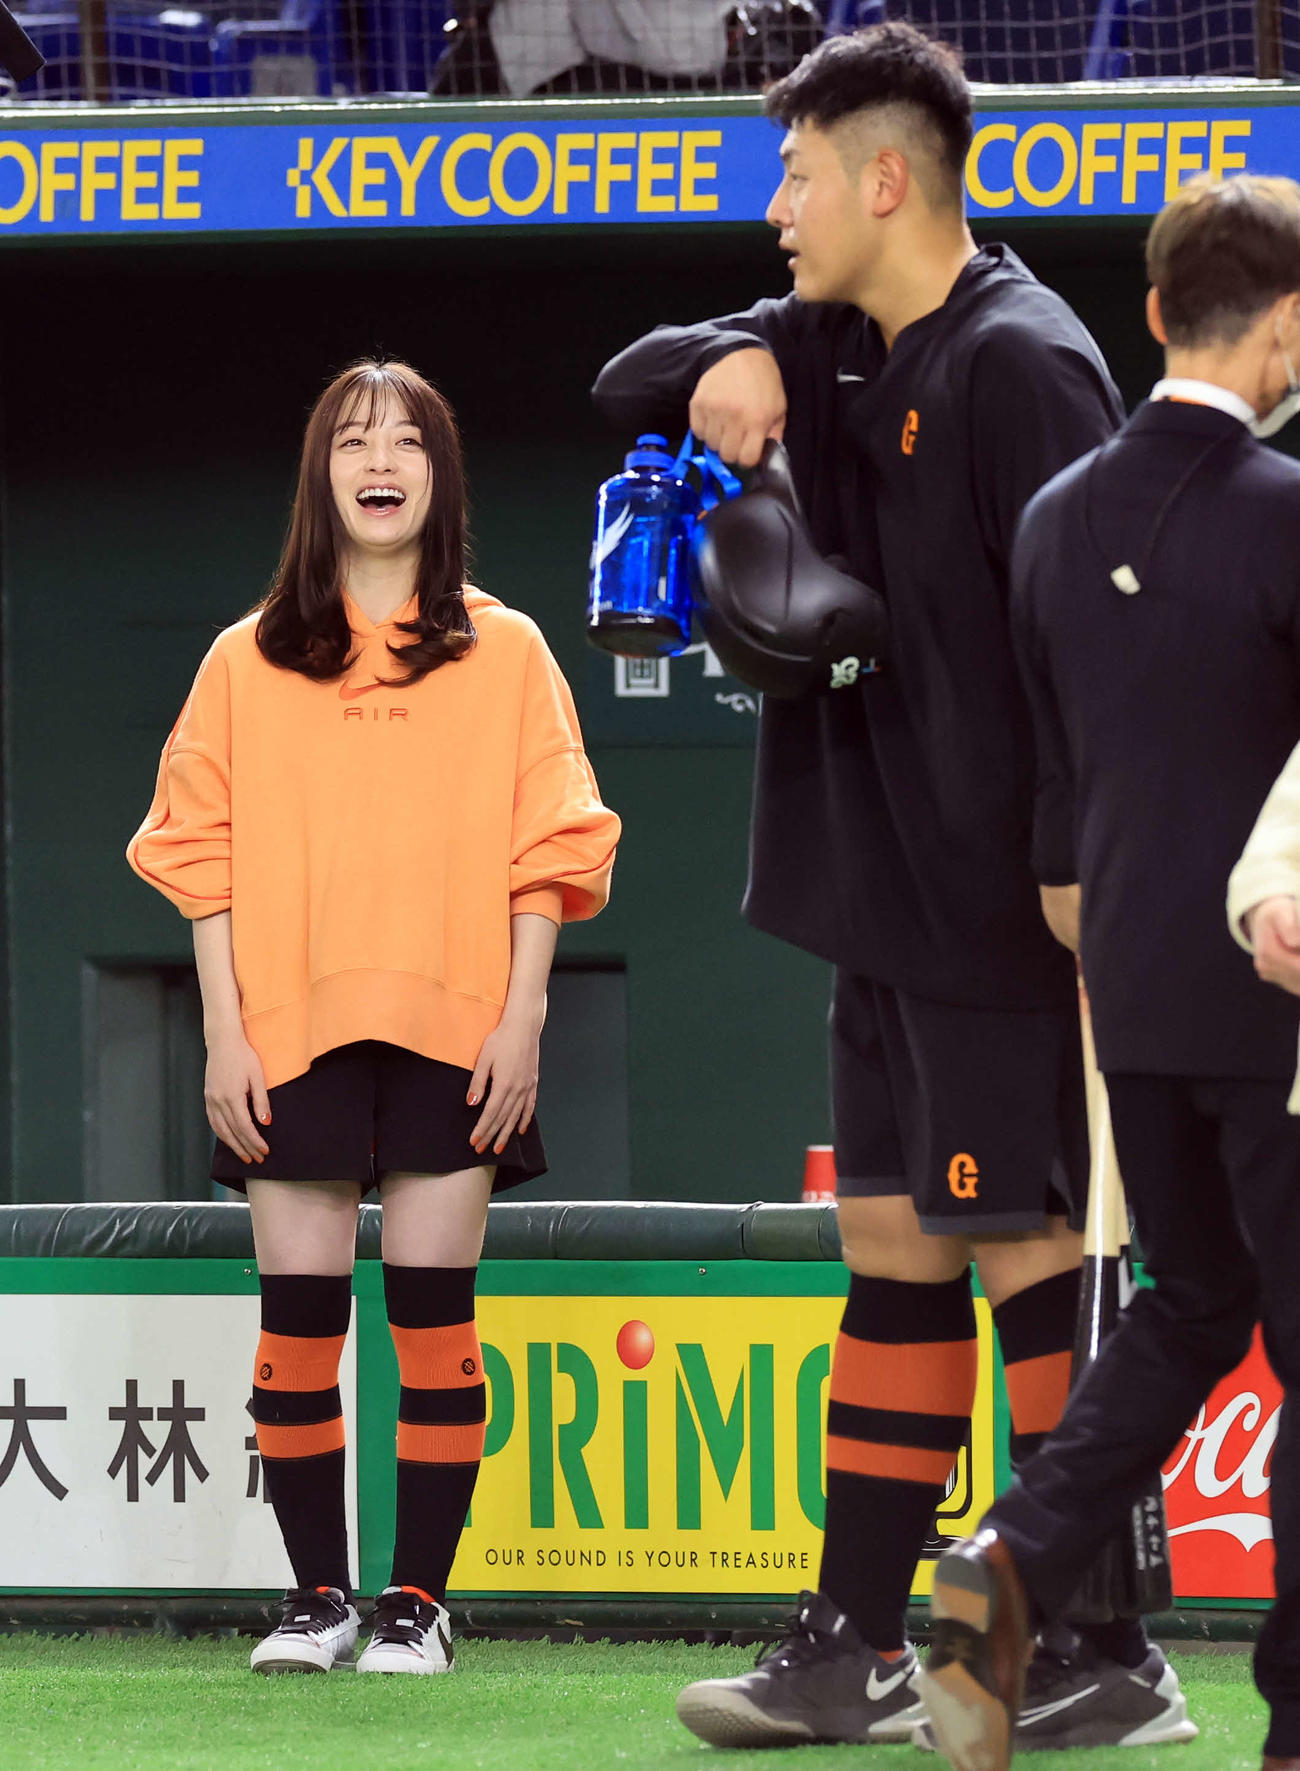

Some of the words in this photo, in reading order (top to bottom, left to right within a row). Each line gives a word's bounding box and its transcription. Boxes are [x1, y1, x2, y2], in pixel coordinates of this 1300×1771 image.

[343, 706, 409, 721] AIR
[947, 1152, 980, 1200] G
[0, 1377, 273, 1504] 大林
[485, 1548, 525, 1566] OUR
[536, 1549, 607, 1567] SOUND
[617, 1550, 634, 1567] IS
[645, 1550, 699, 1568] YOUR
[709, 1551, 809, 1569] TREASURE
